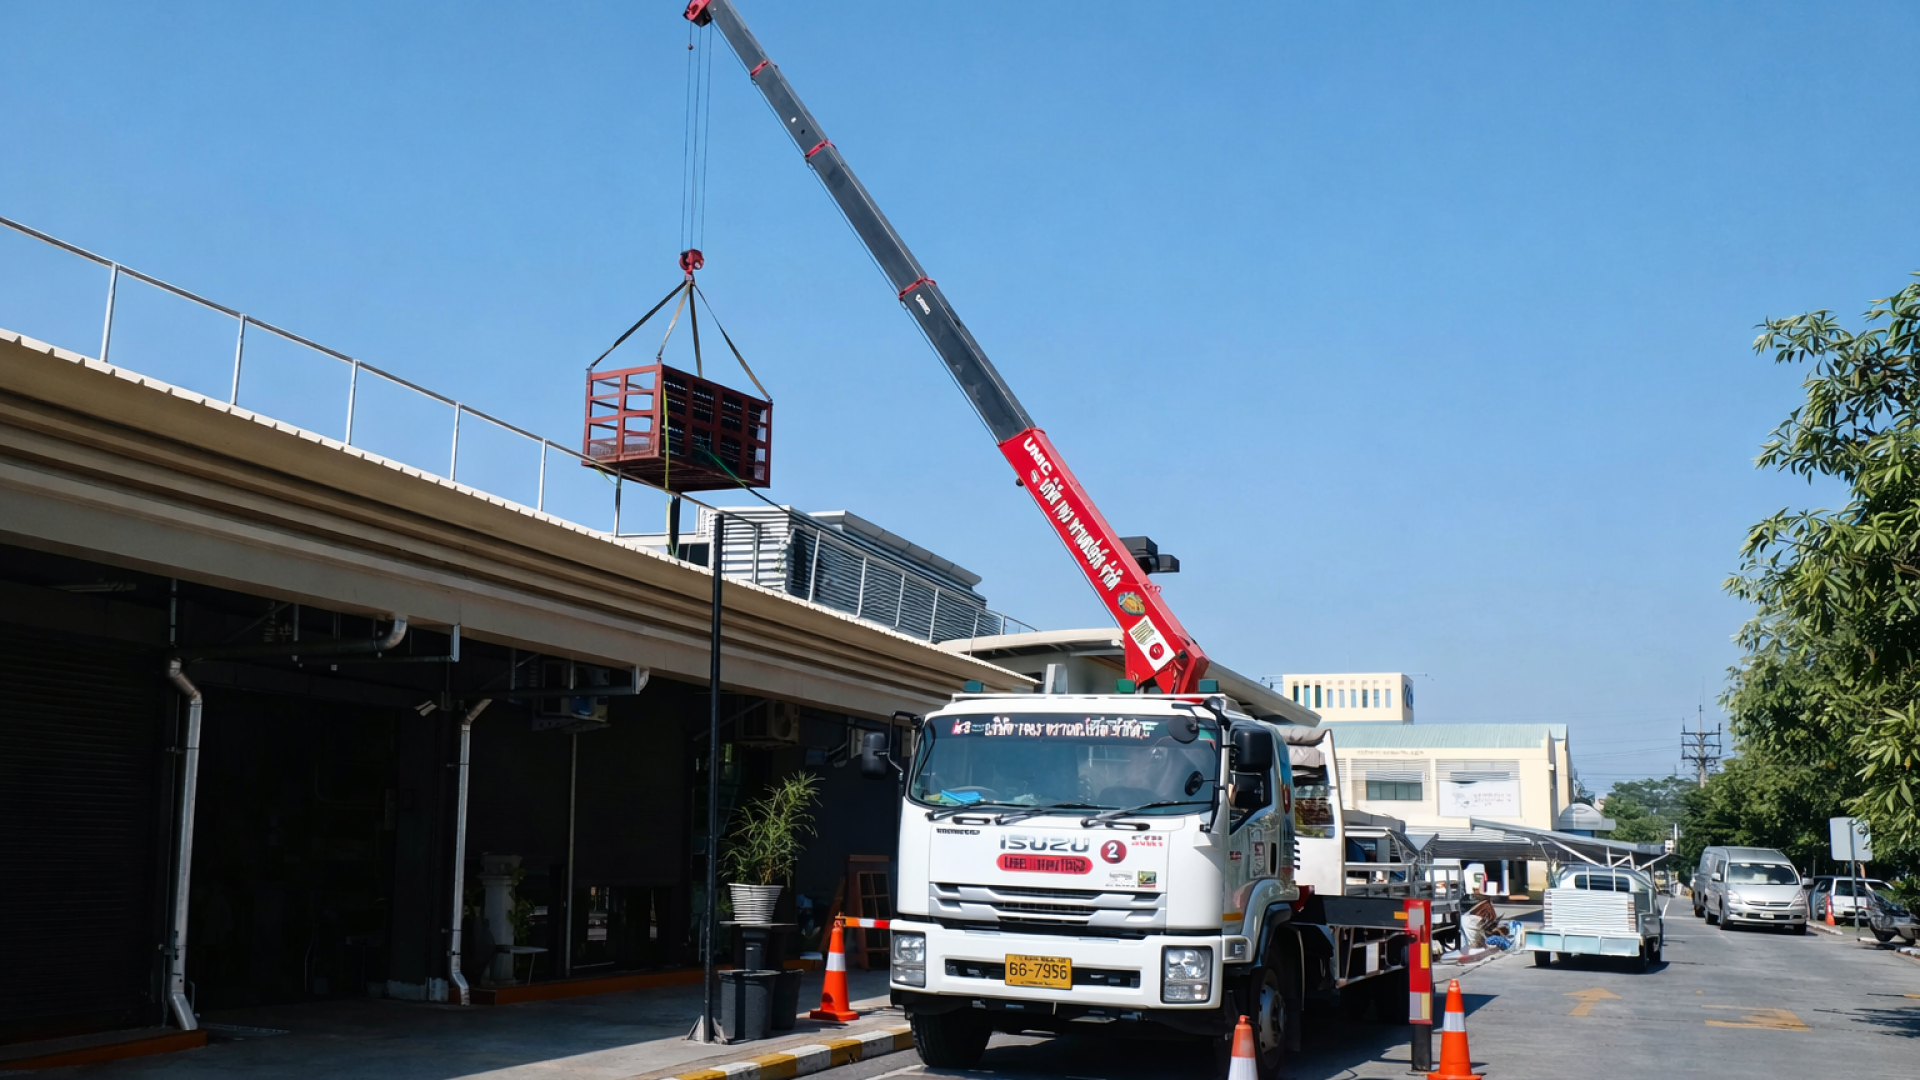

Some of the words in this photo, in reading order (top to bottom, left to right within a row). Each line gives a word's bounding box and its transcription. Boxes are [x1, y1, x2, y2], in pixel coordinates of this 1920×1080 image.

[1023, 436, 1053, 476] UNIC
[1000, 834, 1090, 853] ISUZU
[1107, 842, 1119, 859] 2
